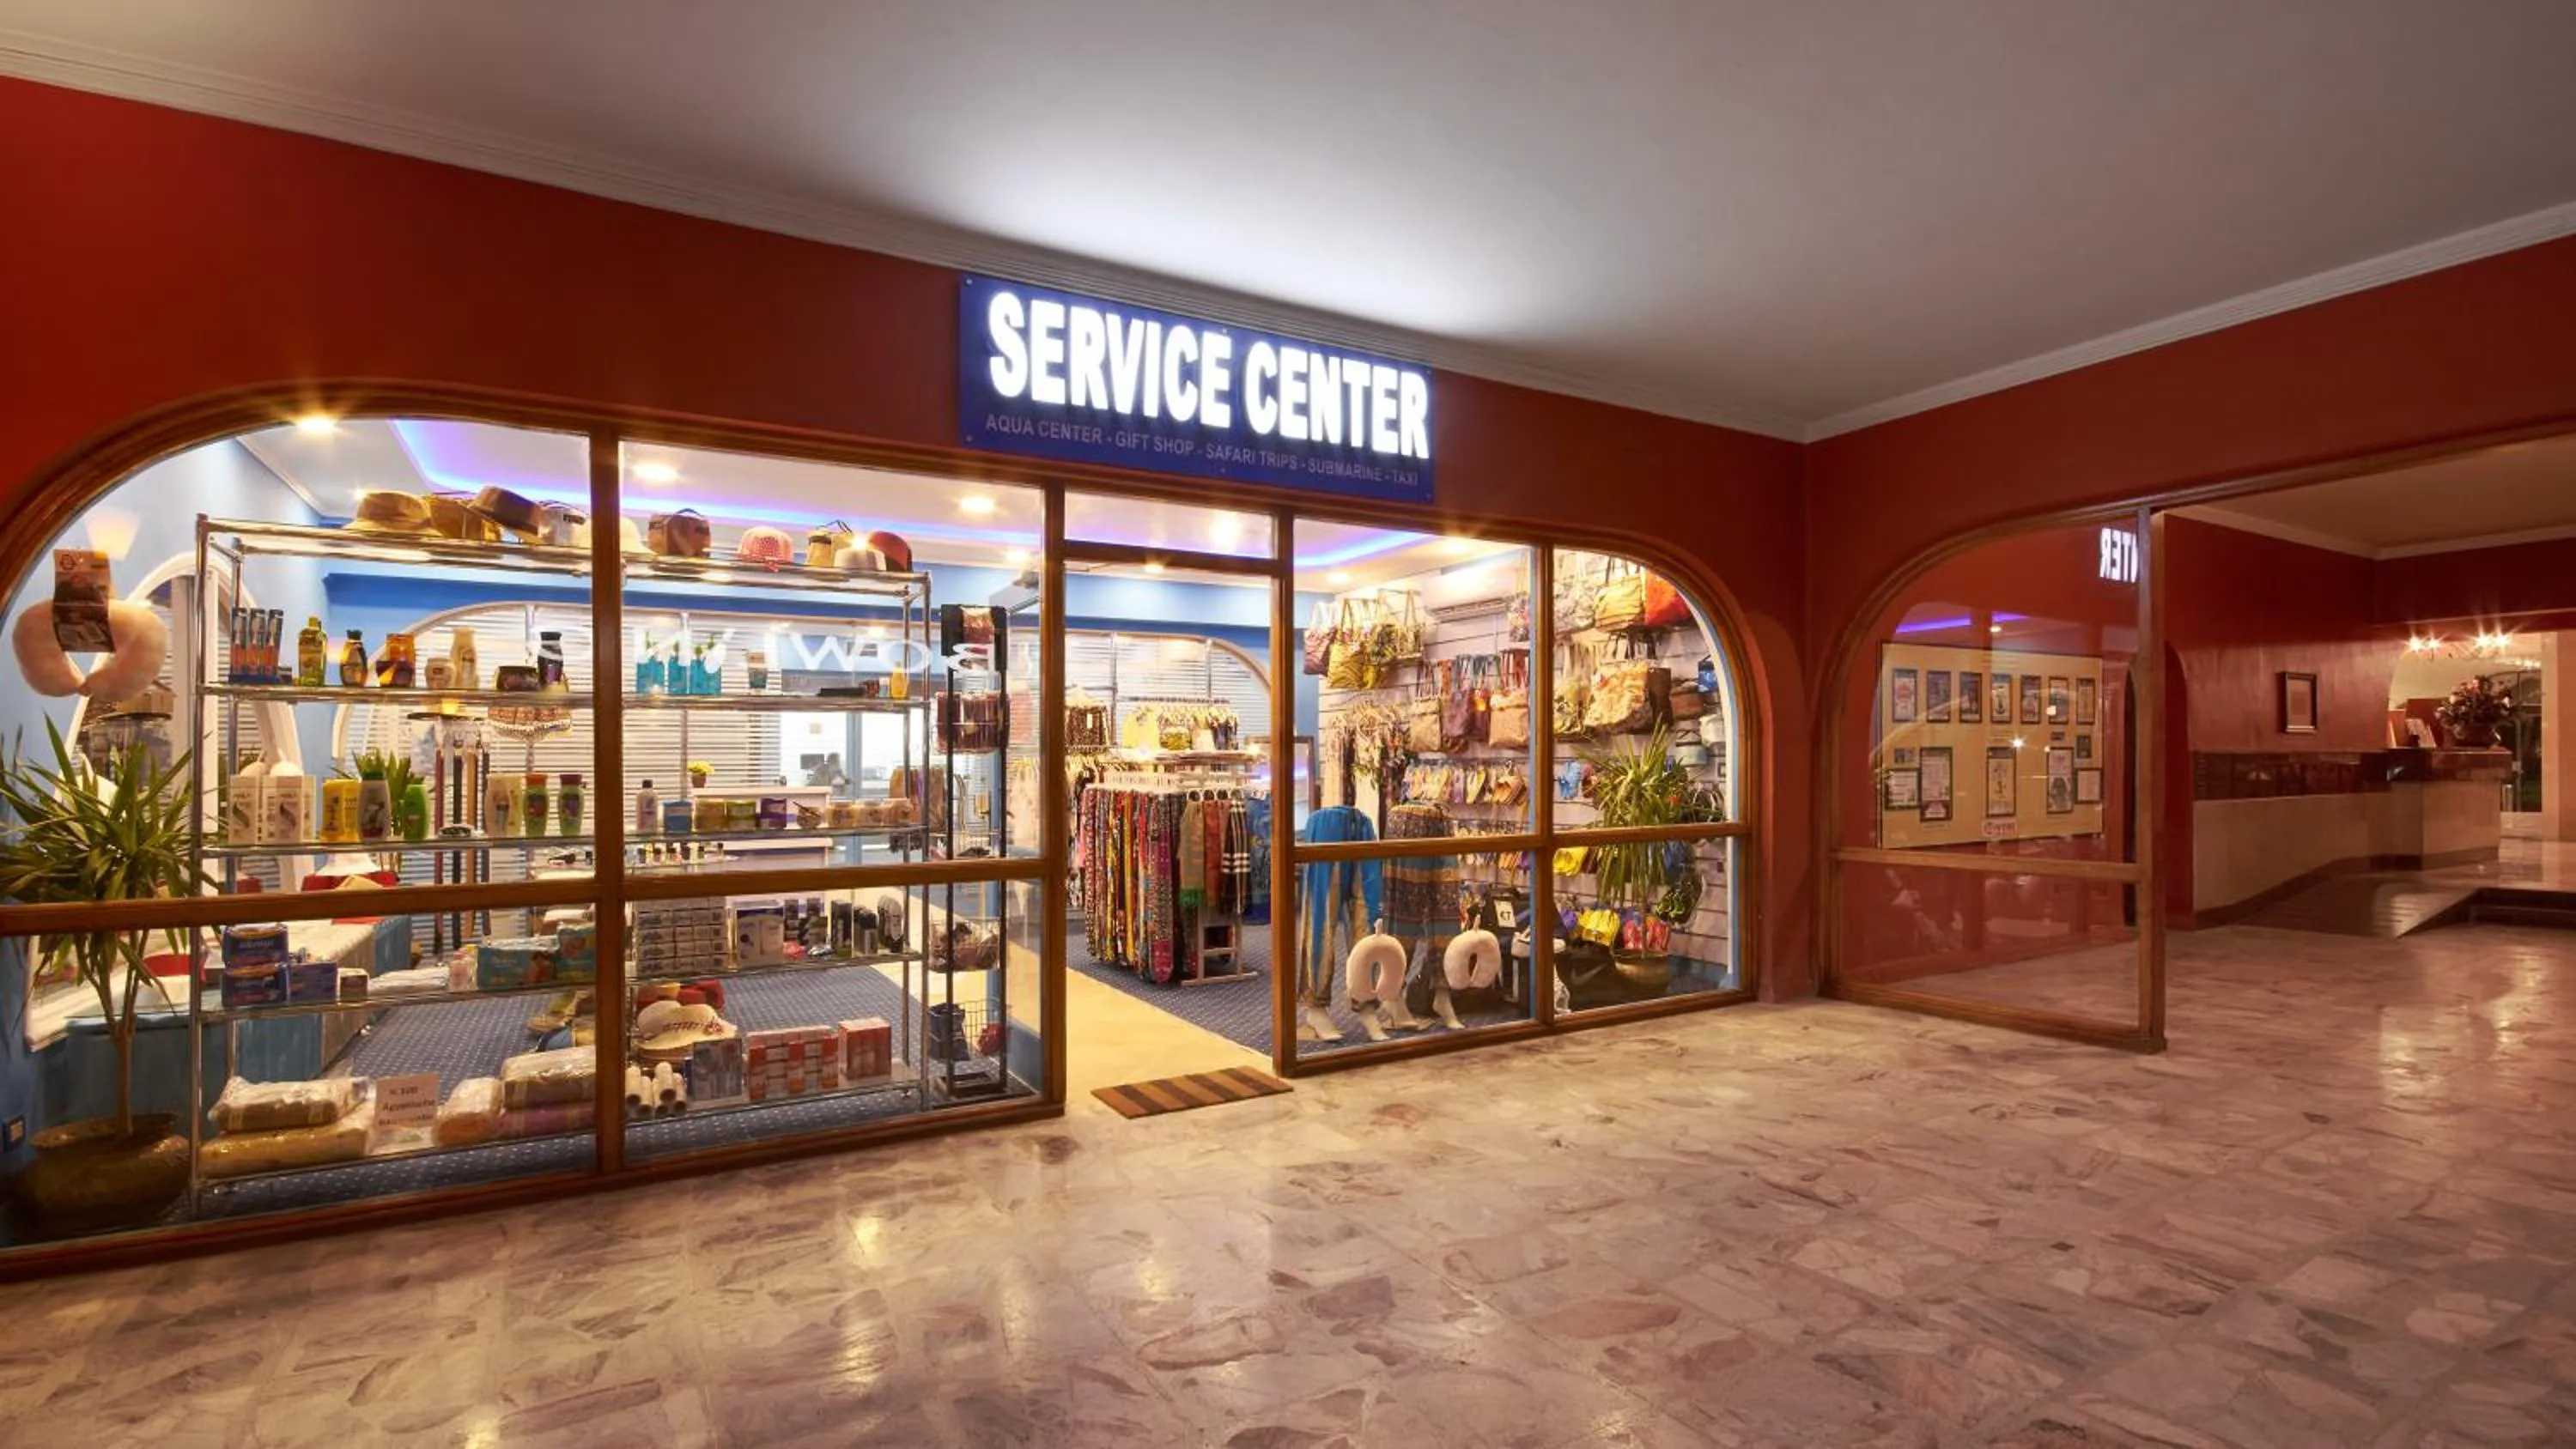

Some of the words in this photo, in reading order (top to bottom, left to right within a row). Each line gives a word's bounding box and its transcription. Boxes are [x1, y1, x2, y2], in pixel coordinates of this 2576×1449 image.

[988, 291, 1231, 428] SERVICE
[1245, 340, 1430, 458] CENTER
[986, 414, 1034, 434] AQUA
[1037, 421, 1103, 444] CENTER
[1115, 431, 1150, 451] GIFT
[1153, 436, 1195, 456] SHOP
[1206, 442, 1256, 464] SAFARI
[1261, 451, 1298, 470] TRIPS
[1308, 458, 1382, 482] SUBMARINE
[1393, 470, 1419, 487] TAXI
